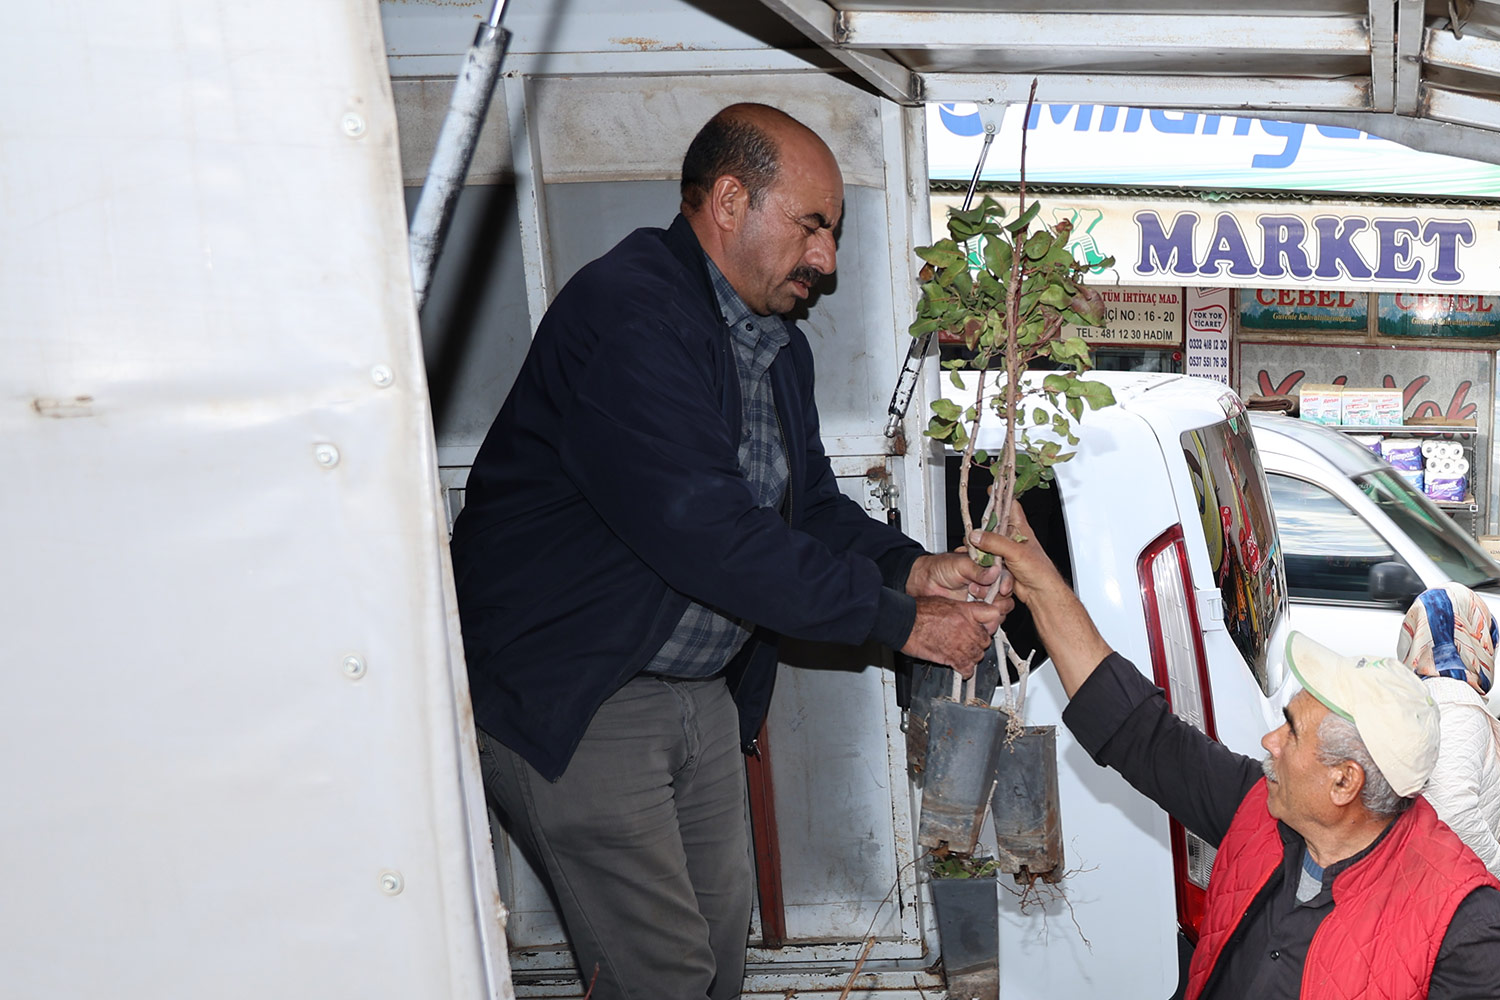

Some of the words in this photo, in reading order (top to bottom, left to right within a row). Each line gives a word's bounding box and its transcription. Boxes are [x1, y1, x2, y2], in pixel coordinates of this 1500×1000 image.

[1135, 211, 1475, 283] MARKET
[1102, 289, 1120, 302] TÜM
[1123, 289, 1157, 306] İHTİYAÇ
[1159, 293, 1179, 304] MAD.
[1120, 310, 1135, 321] NO
[1144, 311, 1155, 321] 16
[1164, 311, 1174, 322] 20
[1076, 327, 1093, 338] TEL
[1101, 329, 1115, 338] 481
[1119, 329, 1128, 339] 12
[1131, 330, 1141, 339] 30
[1144, 329, 1172, 340] HADİM
